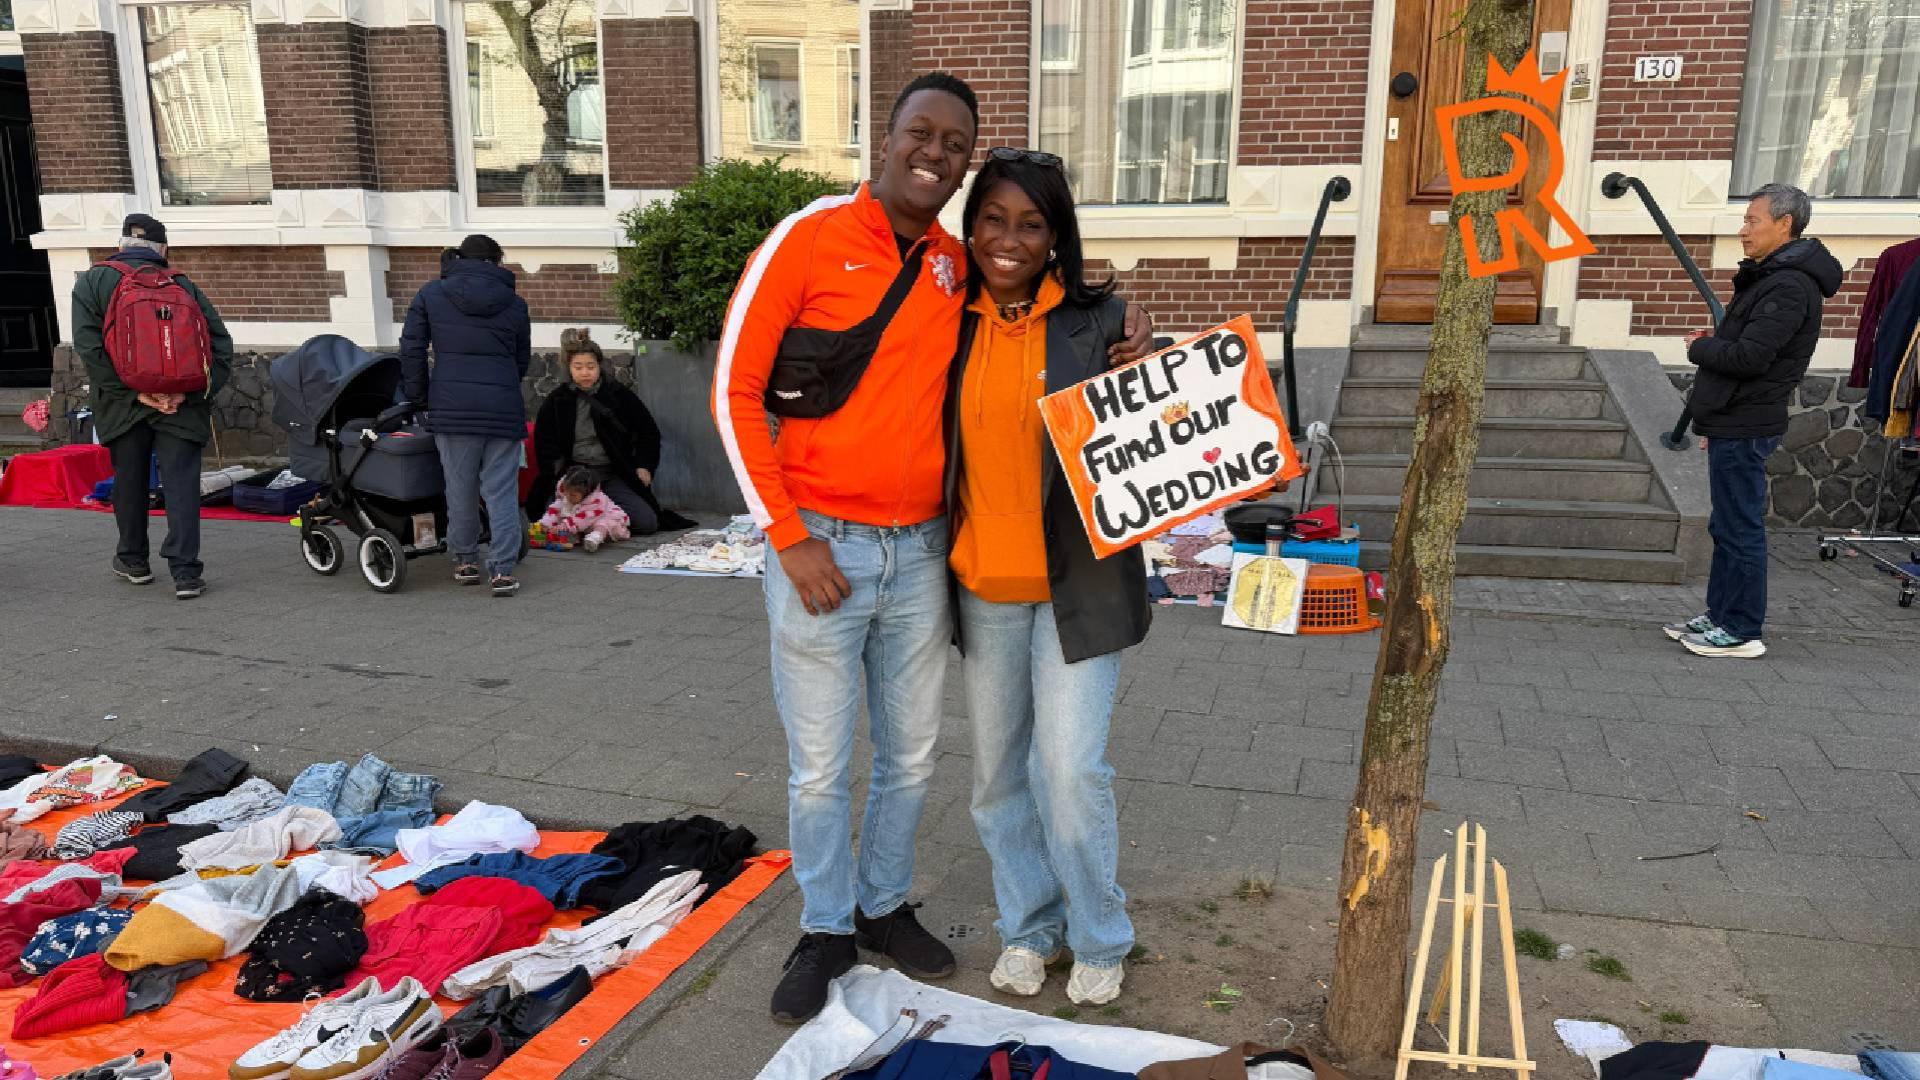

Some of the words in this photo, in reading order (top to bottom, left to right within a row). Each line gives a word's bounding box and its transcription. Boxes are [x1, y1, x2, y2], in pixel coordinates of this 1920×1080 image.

[1639, 59, 1676, 79] 130
[1084, 349, 1188, 423] HELP
[1192, 333, 1248, 376] TO
[1083, 420, 1166, 483] Fund
[1093, 441, 1280, 538] WEDDING
